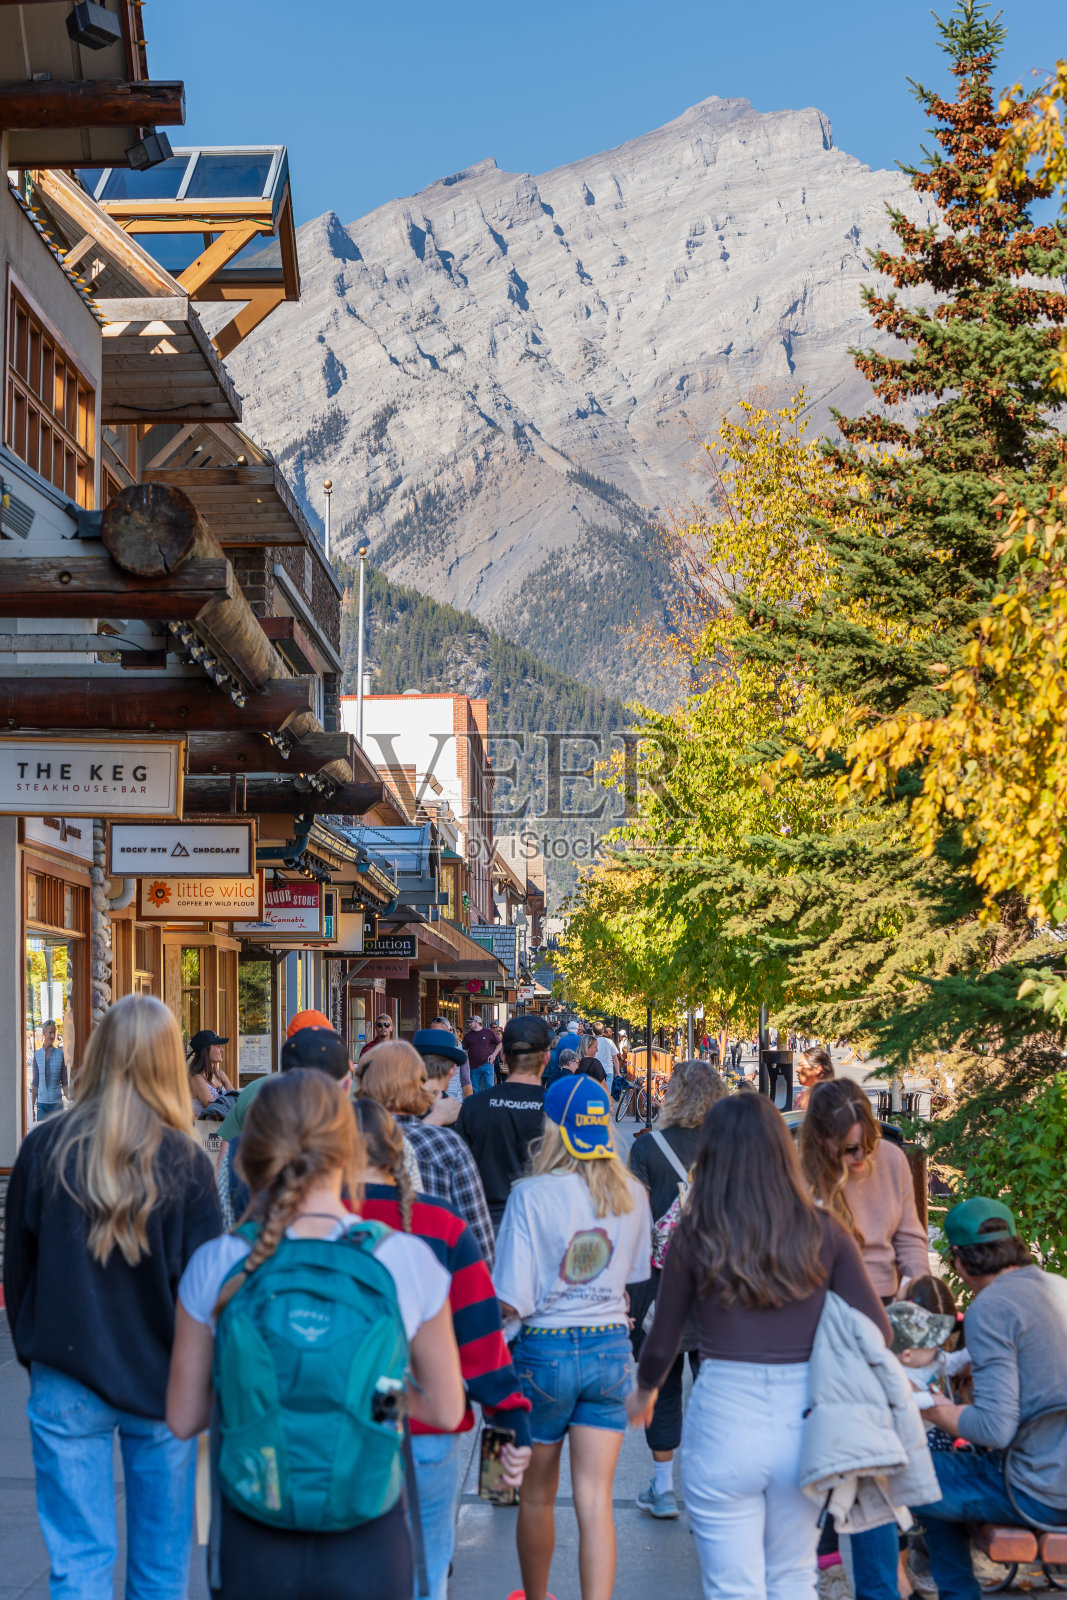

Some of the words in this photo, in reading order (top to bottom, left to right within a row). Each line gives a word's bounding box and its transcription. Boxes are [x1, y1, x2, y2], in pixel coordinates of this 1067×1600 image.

[17, 763, 72, 780] THE
[90, 764, 147, 782] KEG
[177, 882, 215, 898] little
[219, 882, 255, 898] wild
[264, 890, 291, 906] IQUOR
[293, 895, 316, 906] STORE
[365, 937, 411, 949] olution
